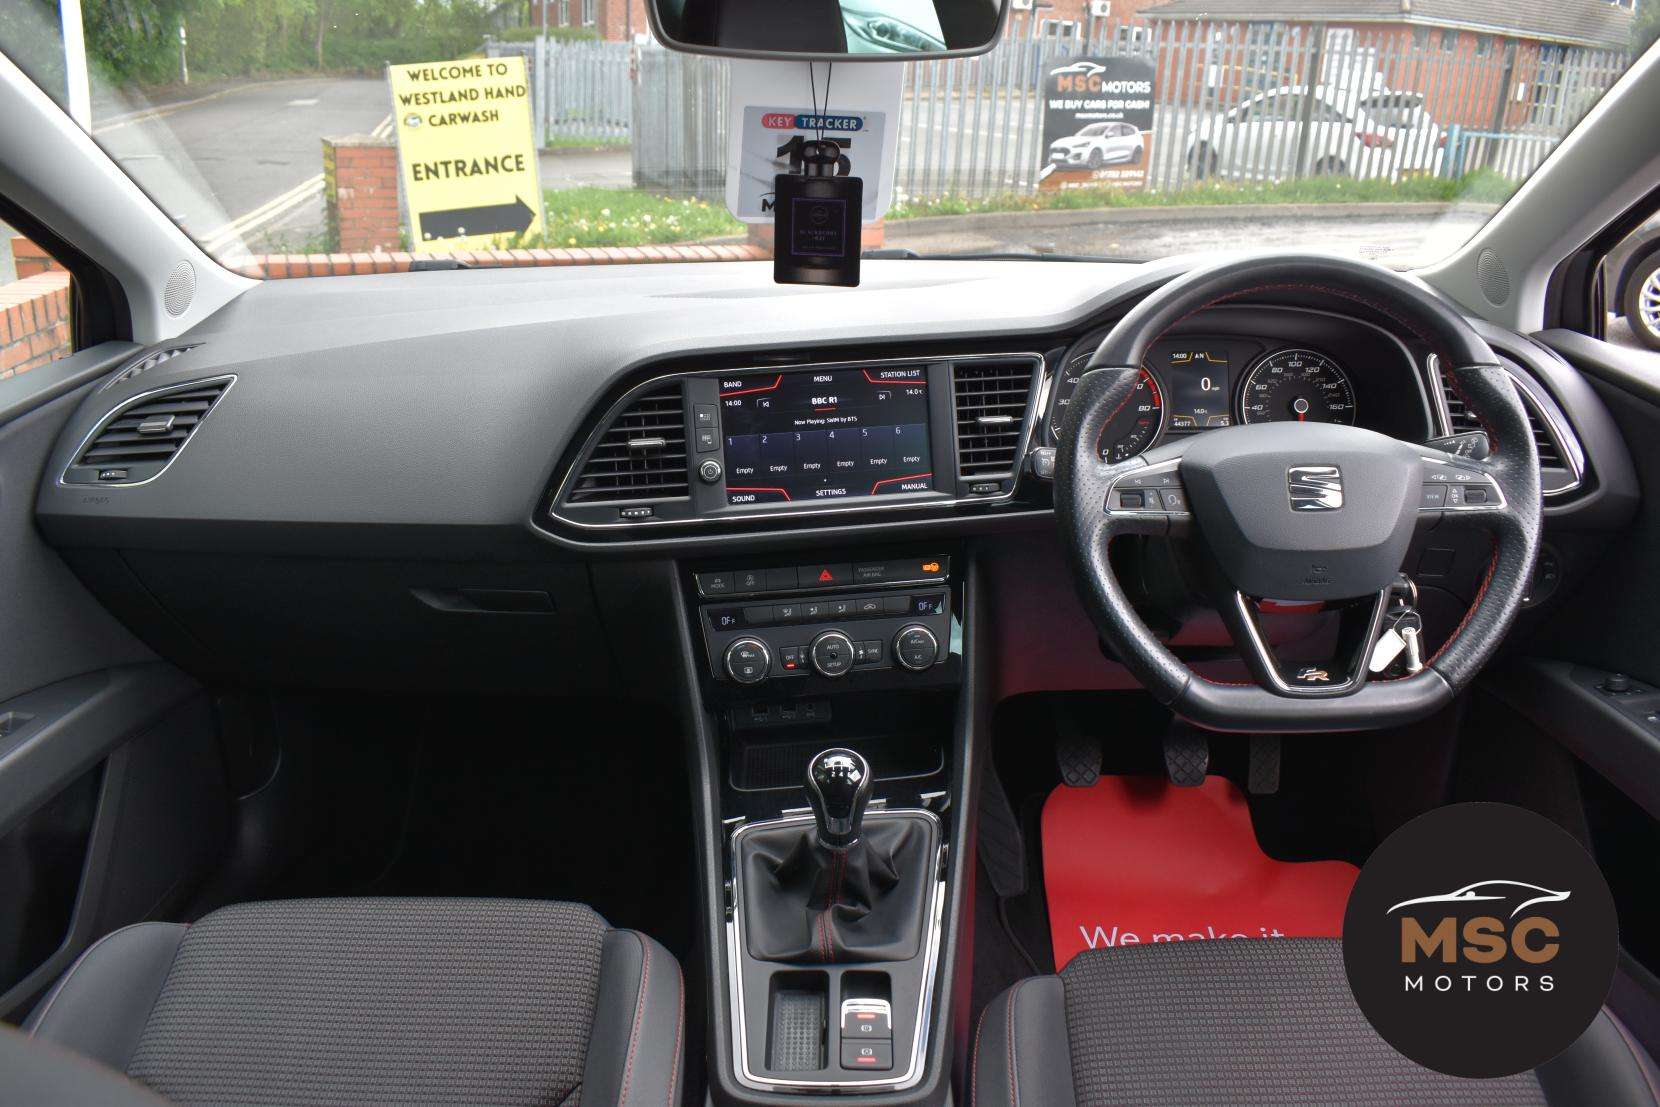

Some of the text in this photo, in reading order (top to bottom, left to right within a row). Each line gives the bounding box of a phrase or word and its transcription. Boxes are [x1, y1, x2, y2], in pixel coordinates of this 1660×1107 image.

[407, 63, 508, 81] WELCOME TO
[1101, 80, 1151, 94] MOTORS
[399, 85, 526, 106] WESTLAND HAND
[1049, 100, 1064, 110] WE
[1065, 100, 1083, 110] BUY
[1084, 100, 1106, 110] CARS
[1107, 100, 1124, 110] FOR
[428, 110, 499, 127] CARWASH
[767, 117, 857, 129] KEY TRACKER
[412, 154, 525, 181] ENTRANCE
[880, 371, 906, 379] STATION
[1201, 377, 1211, 391] 0
[811, 395, 838, 405] BBC R1
[829, 430, 835, 438] 4
[862, 428, 868, 437] 5
[895, 426, 901, 435] 6
[728, 437, 733, 446] 1
[762, 435, 768, 444] 2
[795, 433, 801, 441] 3
[870, 458, 888, 466] Empty
[903, 455, 921, 463] Empty
[803, 462, 821, 470] Empty
[836, 460, 855, 468] Empty
[736, 467, 754, 475] Empty
[769, 465, 788, 473] Empty
[901, 482, 928, 491] MANUAL
[815, 488, 847, 497] SETTINGS
[732, 495, 756, 503] SOUND
[1079, 926, 1140, 949] We
